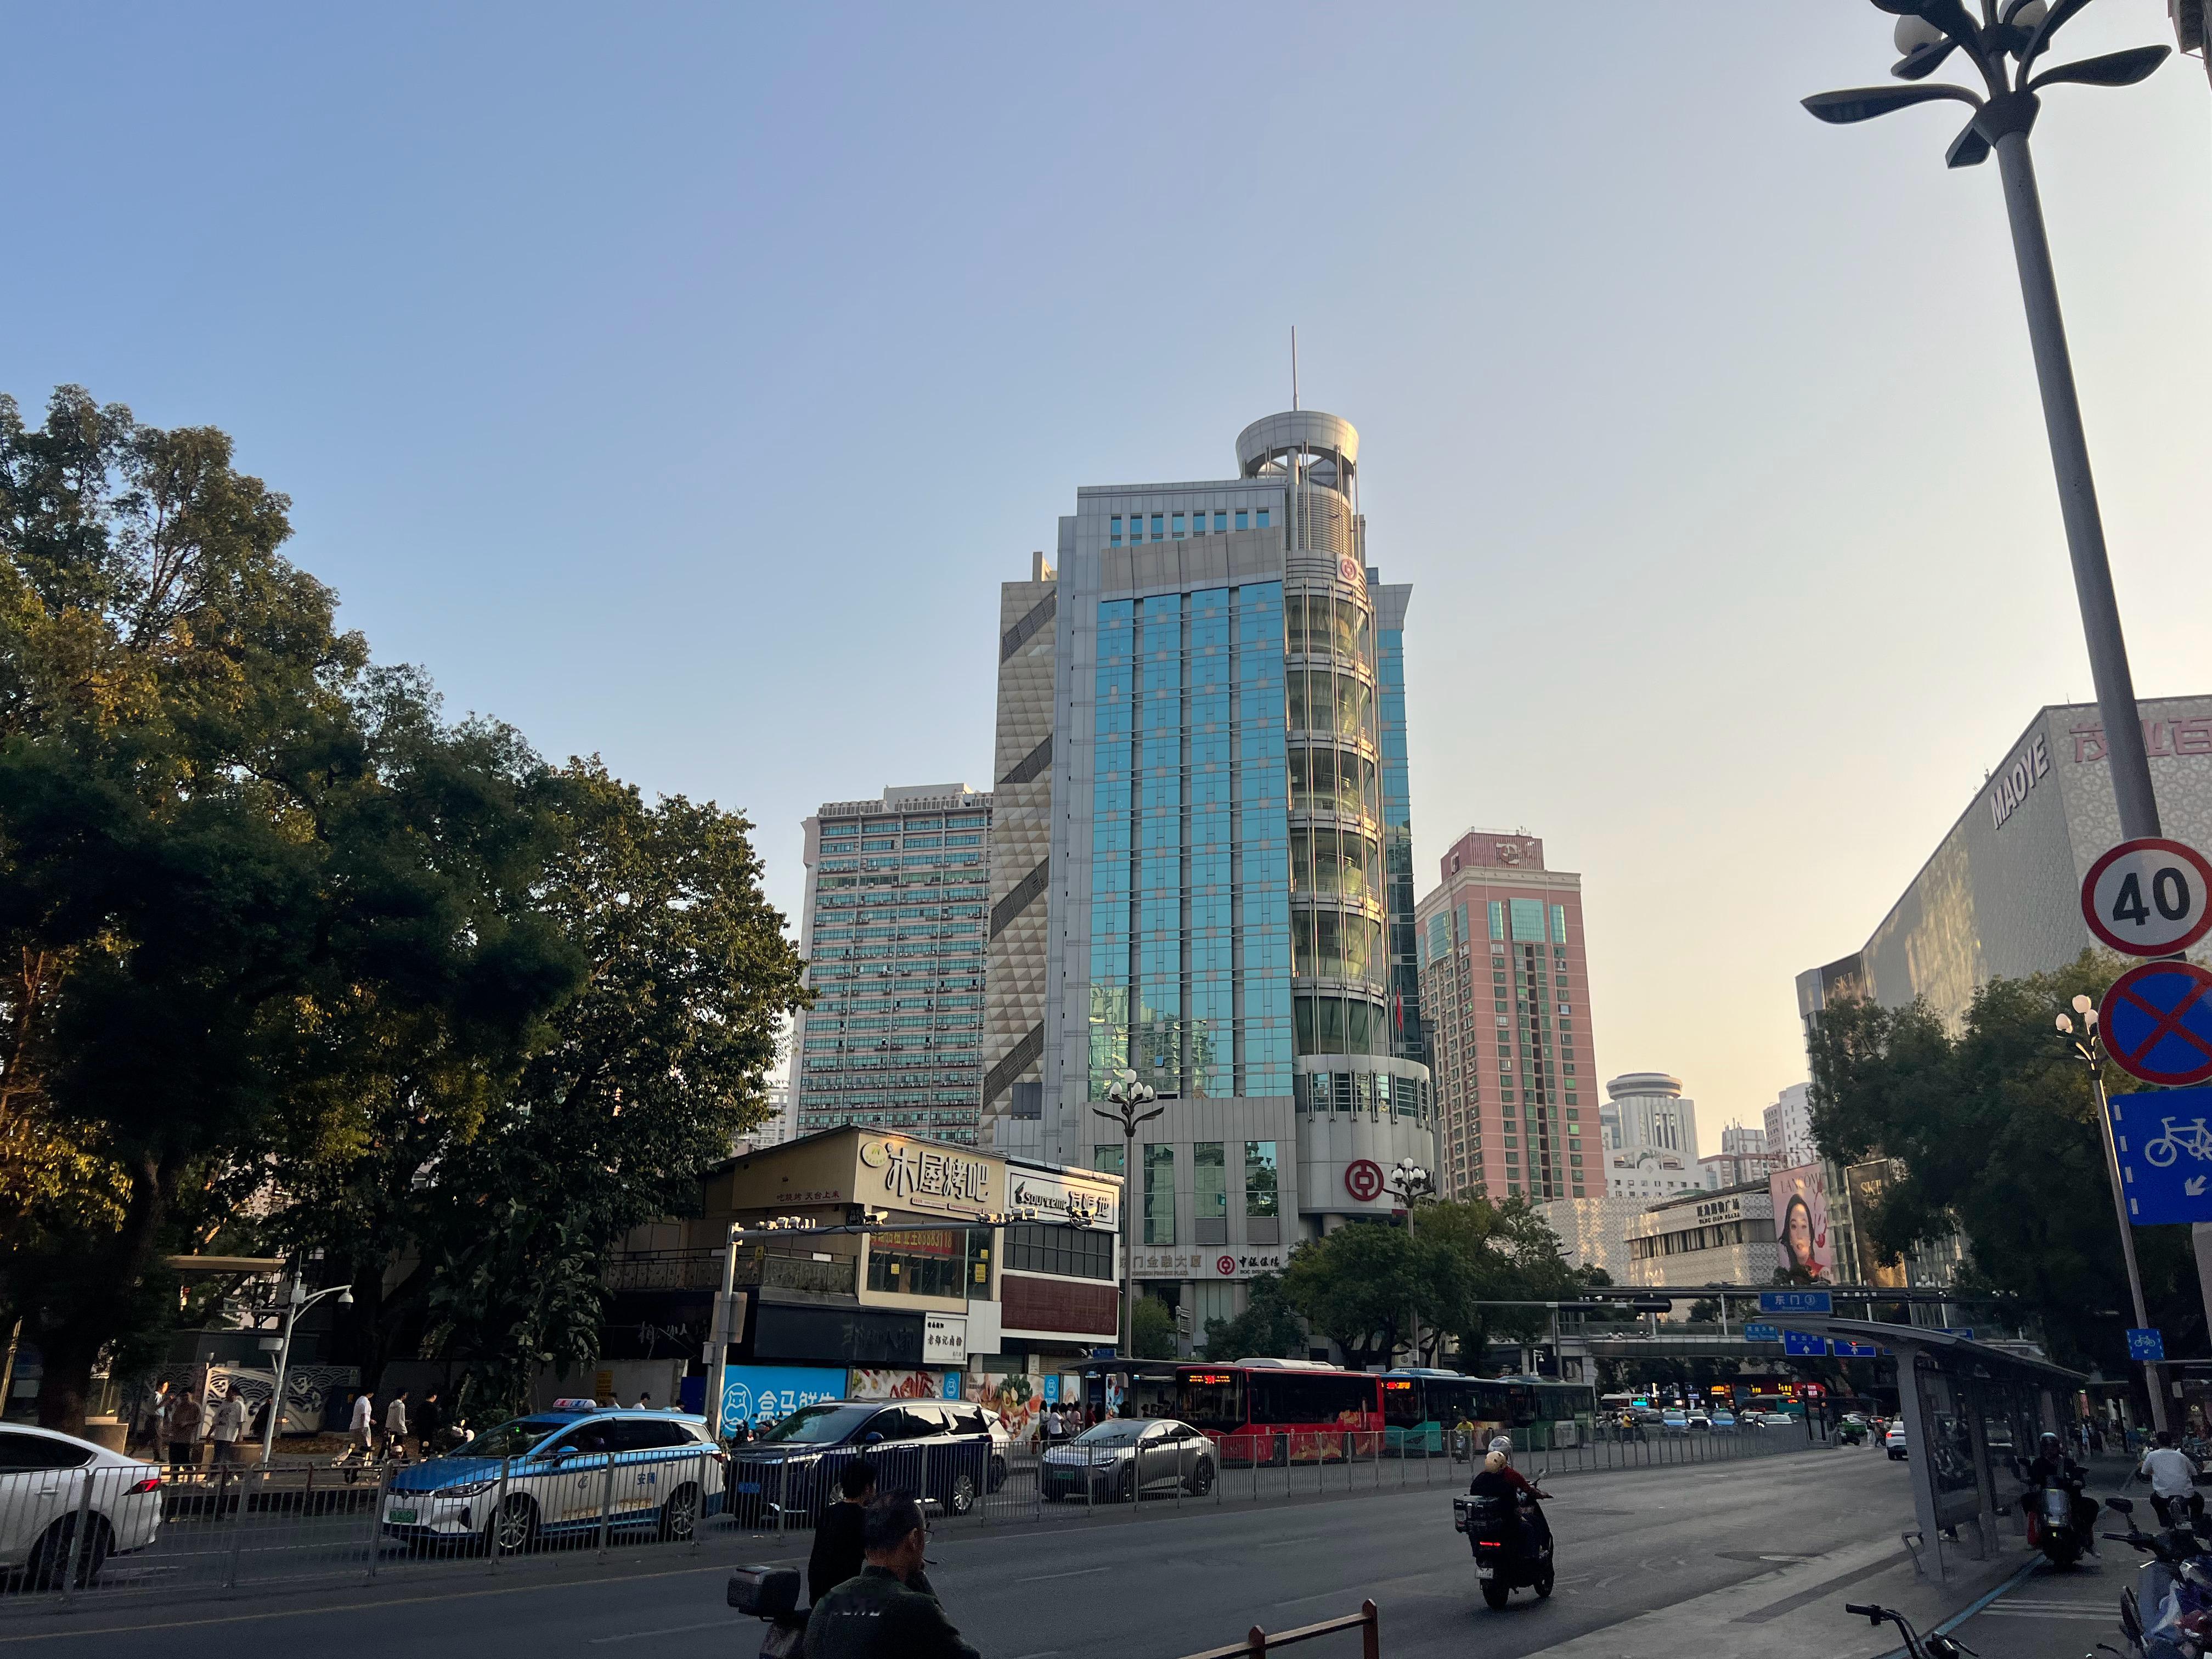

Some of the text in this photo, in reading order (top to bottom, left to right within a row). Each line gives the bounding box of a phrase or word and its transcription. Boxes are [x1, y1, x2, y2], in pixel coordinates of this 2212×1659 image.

[1989, 733, 2050, 830] MAOYE
[2112, 867, 2191, 927] 40
[887, 1147, 990, 1203] 木屋烤吧
